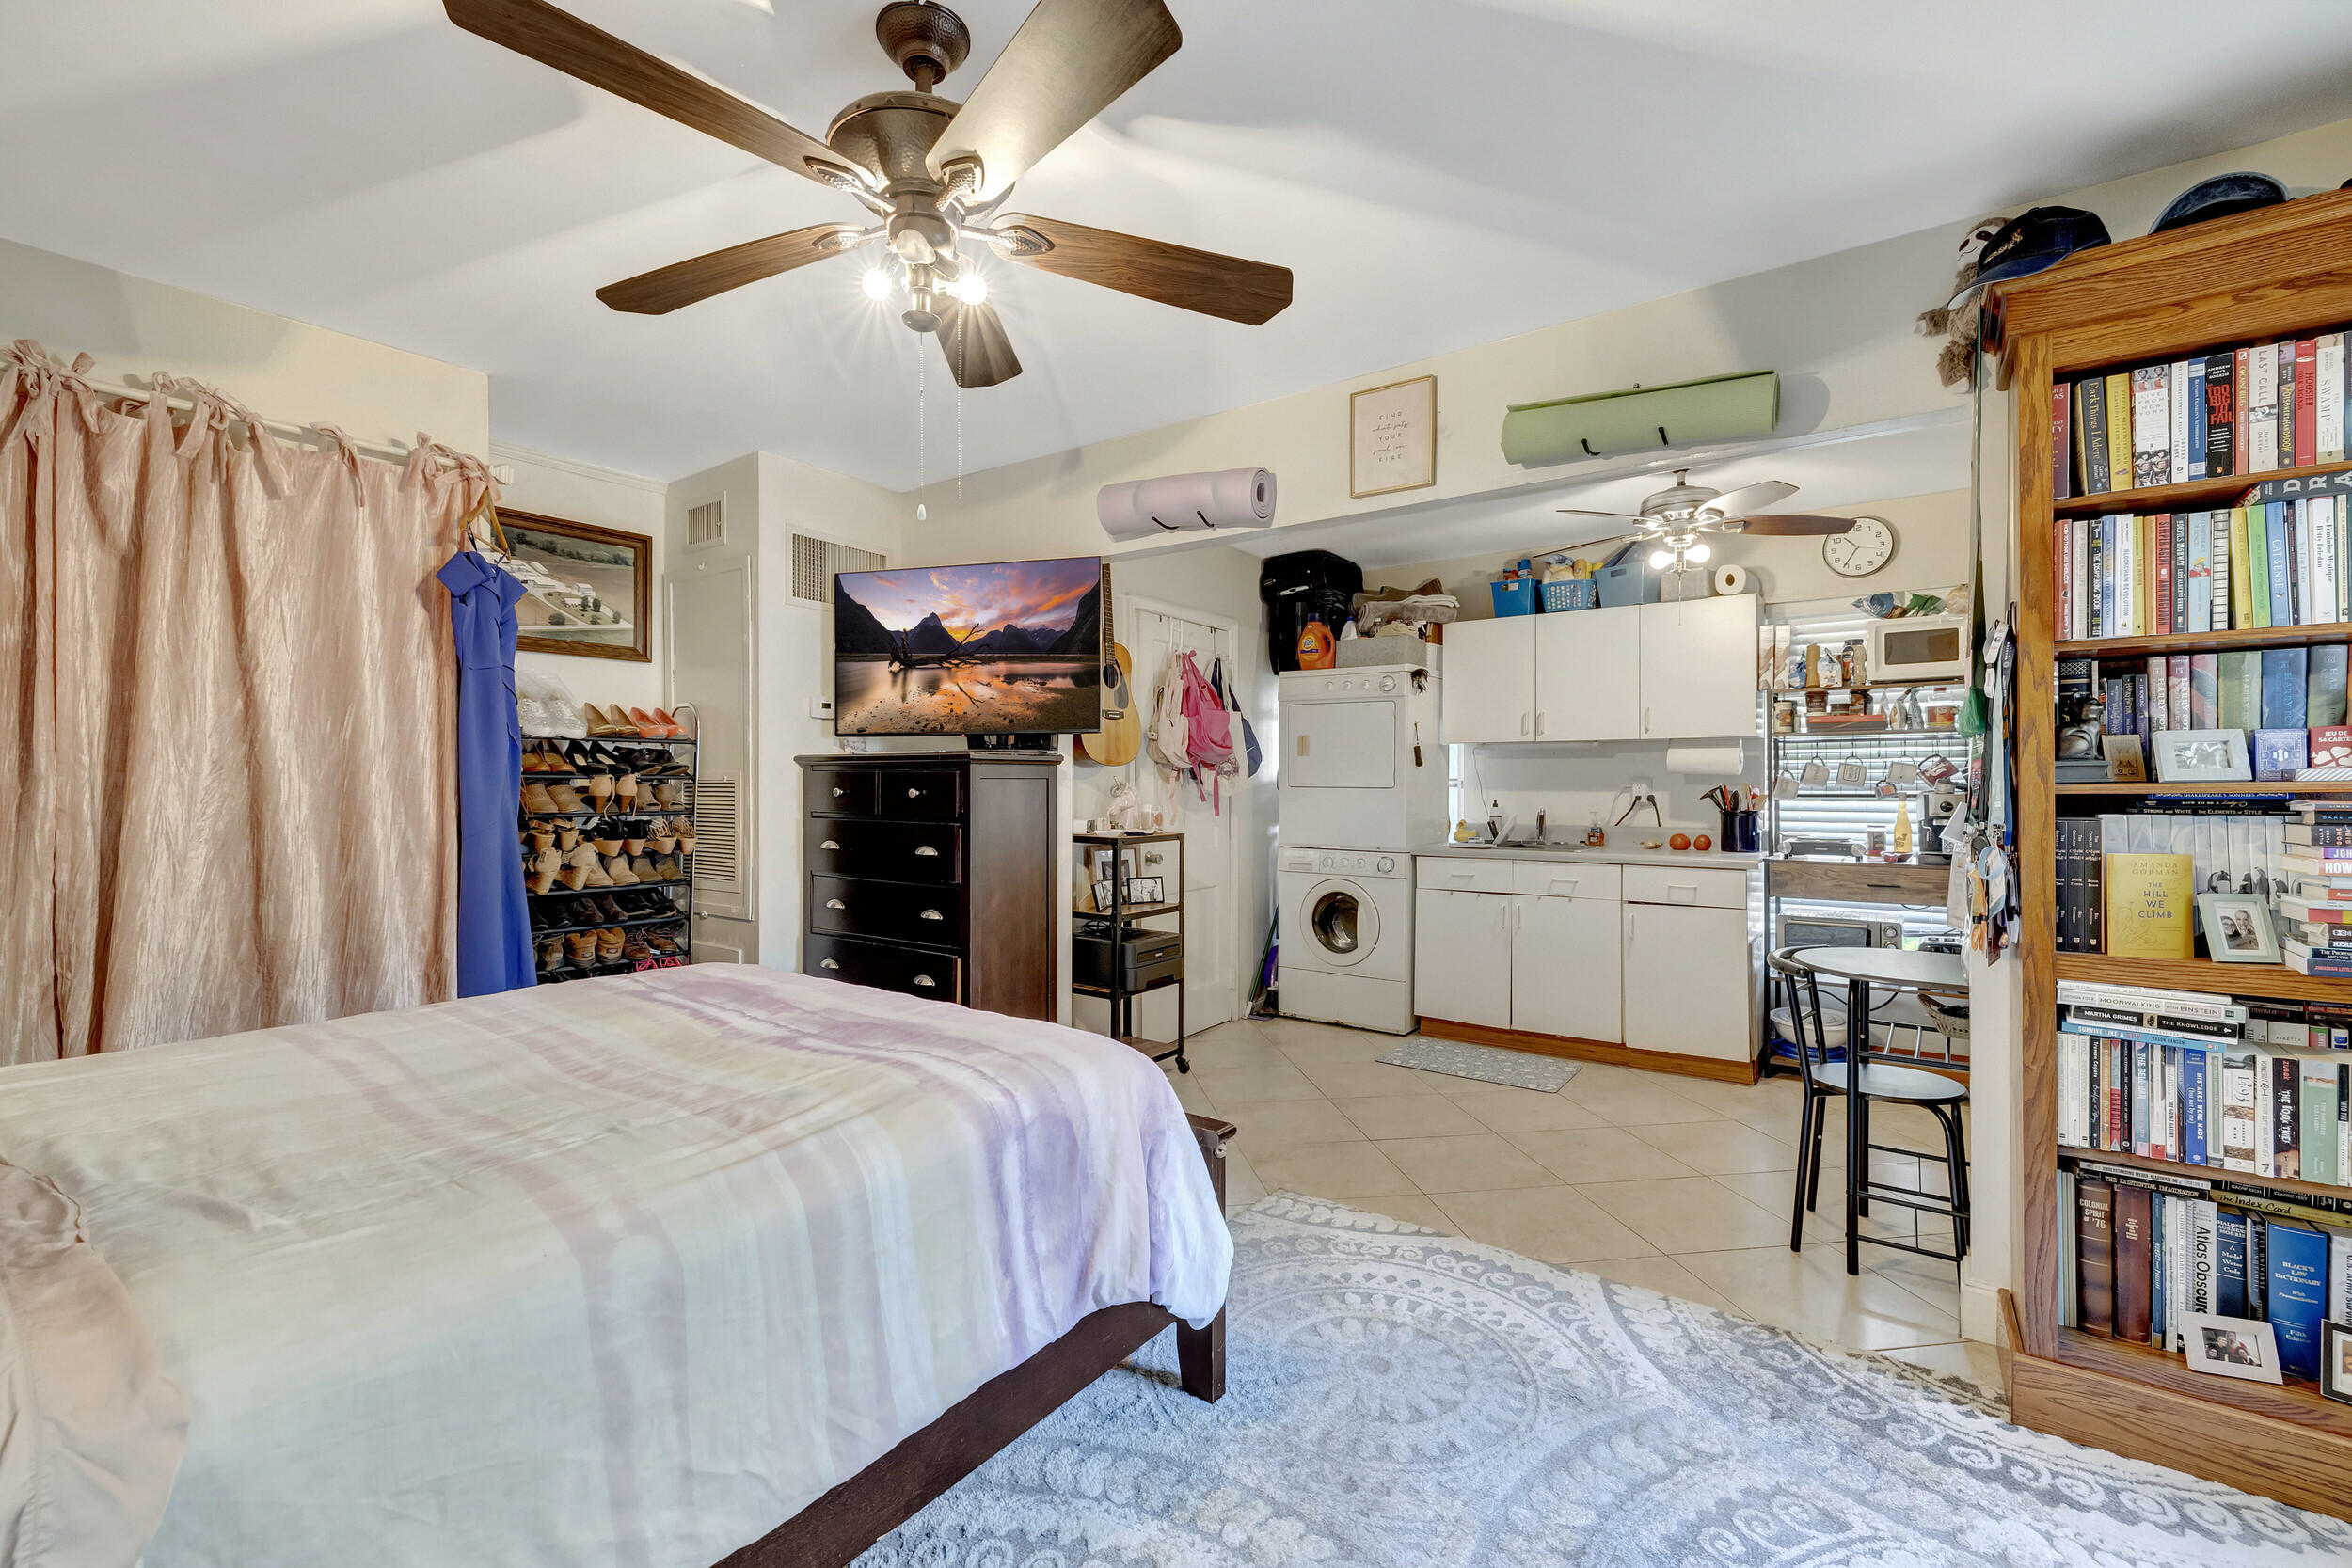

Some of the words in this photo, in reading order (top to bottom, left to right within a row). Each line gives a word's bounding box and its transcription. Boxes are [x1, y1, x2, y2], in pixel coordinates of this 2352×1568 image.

[2258, 350, 2268, 374] LAST
[2089, 382, 2100, 404] Dark
[2207, 384, 2230, 396] TOO
[2258, 378, 2268, 403] CALL
[2305, 372, 2313, 406] HOOSIER
[2209, 394, 2231, 407] BIG
[2321, 379, 2331, 421] SWAMP
[1379, 411, 1402, 420] FIND
[2089, 404, 2101, 429] Things
[2214, 404, 2229, 415] TO
[2210, 411, 2233, 425] FAIL
[1378, 433, 1402, 442] YOUR
[2281, 420, 2292, 453] HANDBOOK
[2092, 437, 2103, 459] Adore
[1378, 454, 1402, 462] FIRE
[2159, 522, 2169, 546] SLEEPER
[2315, 525, 2323, 543] Betty
[2272, 539, 2282, 557] CAT
[2159, 548, 2169, 566] AGENT
[2273, 559, 2284, 589] SENSE
[2159, 580, 2169, 592] ANN
[2284, 673, 2293, 710] HARRY
[2325, 863, 2352, 874] HOW
[2099, 997, 2161, 1010] MOONWALKING
[2180, 1005, 2219, 1016] EINSTEIN
[2084, 1010, 2111, 1019] MARTHA
[2112, 1013, 2138, 1022] GRIMES
[2078, 1026, 2104, 1036] SURVIVE
[2105, 1029, 2119, 1038] LIKE
[2126, 1031, 2141, 1041] SPY
[2176, 1021, 2218, 1032] KNOWLEDGE
[2167, 1037, 2185, 1045] HANSON
[2236, 1076, 2252, 1102] 1493
[2280, 1090, 2291, 1104] THE
[2280, 1105, 2293, 1124] BOOK
[2281, 1125, 2291, 1144] THIEF
[2102, 1166, 2134, 1176] UNDERSTANDING
[2119, 1179, 2157, 1190] EXISTENTIAL
[2158, 1185, 2199, 1197] IMAGINATION
[2273, 1191, 2294, 1199] CLASSIC
[2079, 1198, 2110, 1211] COLONIAL
[2235, 1196, 2262, 1208] Index
[2265, 1204, 2292, 1215] Card
[2084, 1208, 2106, 1219] SPIRIT
[2092, 1218, 2106, 1229] '76
[2196, 1225, 2211, 1259] Atlas
[2222, 1251, 2243, 1260] Model
[2222, 1259, 2243, 1267] Water
[2282, 1261, 2315, 1272] BLACK'S
[2223, 1266, 2241, 1275] Code
[2274, 1272, 2321, 1286] DICTIONARY
[2286, 1334, 2311, 1343] Edition
[2289, 1329, 2307, 1338] Fifth
